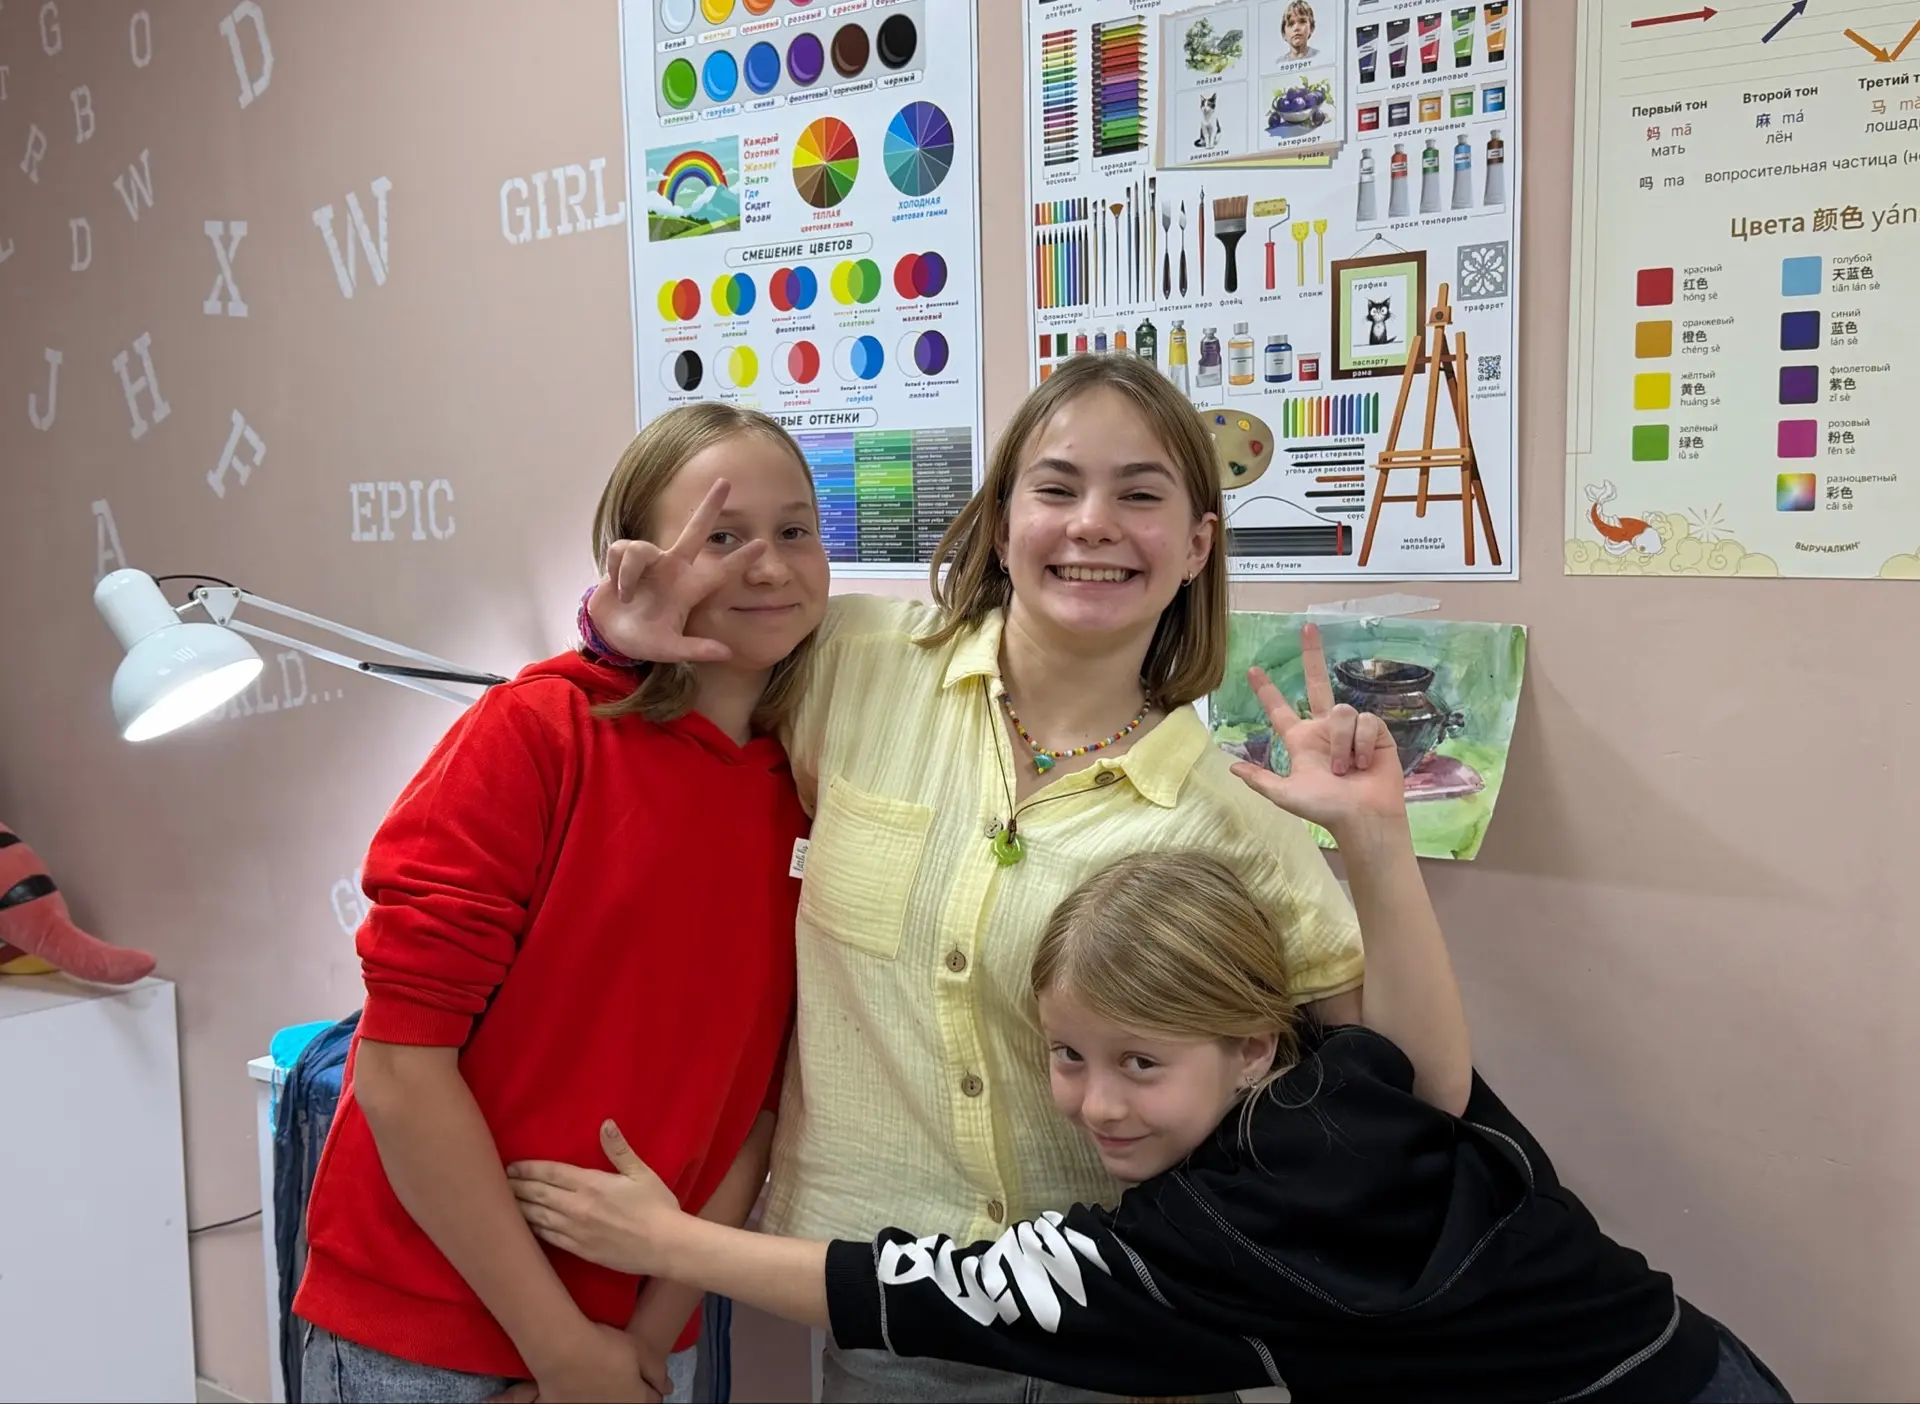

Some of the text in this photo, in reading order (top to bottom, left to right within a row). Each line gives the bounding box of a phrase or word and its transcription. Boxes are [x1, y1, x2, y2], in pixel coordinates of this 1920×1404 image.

[832, 0, 867, 16] красный
[1060, 7, 1082, 17] бумаги
[1394, 1, 1422, 11] краски
[787, 10, 822, 25] розовый
[40, 1, 62, 56] G
[742, 19, 779, 34] оранжевый
[129, 11, 151, 68] O
[664, 38, 687, 50] белый
[220, 0, 274, 109] D
[1280, 60, 1312, 71] портрет
[883, 73, 916, 87] черный
[1196, 76, 1223, 86] пейзаж
[1391, 72, 1469, 90] краски акриловые
[1858, 73, 1910, 91] Третий
[833, 81, 874, 95] коричневый
[1742, 85, 1819, 104] Второй тон
[789, 88, 829, 103] фиолетовый
[753, 99, 775, 110] синий
[1631, 99, 1708, 118] Первый тон
[1871, 99, 1887, 115] 马
[70, 85, 95, 143] B
[706, 105, 736, 119] голубой
[663, 113, 694, 126] зеленый
[1755, 109, 1805, 129] 麻 má
[1393, 122, 1466, 138] краски гуашевые
[1646, 123, 1692, 141] 妈 mā
[743, 133, 779, 148] Каждый
[1277, 135, 1321, 147] натюрморт
[1765, 131, 1793, 145] лён
[20, 124, 47, 184] R
[743, 147, 780, 161] Охотник
[1190, 150, 1230, 161] анимализм
[1297, 151, 1324, 160] бумага
[1650, 143, 1686, 158] мать
[743, 161, 777, 173] Желает
[1100, 160, 1137, 171] карандаши
[1639, 151, 1898, 191] 吗 ma вопросительная частица
[1104, 168, 1133, 177] цветные
[114, 148, 154, 222] W
[744, 174, 769, 186] Знать
[744, 188, 760, 201] Где
[744, 200, 771, 213] Сидит
[898, 196, 941, 210] ХОЛОДНАЯ
[745, 213, 772, 224] Фазан
[812, 209, 841, 220] ТЕПЛАЯ
[892, 208, 949, 224] цветовая гамма
[800, 220, 854, 234] цветовая гамма
[1390, 214, 1468, 231] краски темперные
[1730, 215, 1806, 242] Цвета
[1811, 204, 1865, 234] 颜色
[312, 176, 392, 299] W
[70, 218, 92, 272] D
[742, 239, 853, 262] СМЕШЕНИЕ ЦВЕТОВ
[1832, 253, 1873, 265] голубой
[204, 220, 248, 317] X
[1683, 264, 1723, 275] красный
[1832, 266, 1874, 282] 天蓝色
[1354, 281, 1388, 291] графика
[1683, 277, 1709, 291] 红色
[1832, 281, 1880, 293] tiān lán sè
[1259, 294, 1282, 302] валик
[1298, 291, 1323, 299] спонж
[1683, 291, 1718, 302] hóng sè
[1195, 302, 1213, 310] перо
[1464, 302, 1505, 313] трафарет
[902, 312, 943, 323] малиновый
[1831, 308, 1861, 318] синий
[839, 319, 875, 328] салатовый
[1682, 316, 1735, 328] оранжевый
[1830, 321, 1858, 335] 蓝色
[775, 324, 816, 335] фиолетовый
[1682, 330, 1708, 343] 橙色
[1830, 336, 1858, 346] lán sè
[1709, 343, 1721, 353] sè
[1352, 357, 1389, 367] паспарту
[1352, 369, 1372, 378] рама
[1680, 370, 1716, 380] жёлтый
[1829, 363, 1891, 375] фиолетовый
[28, 346, 63, 431] J
[112, 331, 171, 440] H
[1680, 382, 1707, 396] 黄色
[1829, 377, 1857, 391] 紫色
[1264, 387, 1286, 396] банка
[846, 394, 873, 405] голубой
[1680, 395, 1721, 408] huáng sè
[809, 413, 860, 426] ОТТЕНКИ
[1828, 418, 1871, 429] розовый
[1333, 436, 1365, 444] пастель
[1679, 436, 1705, 449] 绿色
[1827, 431, 1855, 445] 粉色
[1291, 451, 1319, 461] графит
[1845, 446, 1856, 456] sè
[1285, 465, 1365, 476] уголь для рисования
[1826, 473, 1897, 484] разноцветный
[1333, 481, 1365, 490] сангина
[1341, 496, 1365, 504] сепия
[1826, 486, 1854, 501] 彩色
[349, 478, 456, 542] EPIC
[1841, 501, 1853, 511] sè
[1347, 513, 1365, 521] соус
[92, 499, 127, 586] A
[1400, 542, 1446, 551] напольный
[1403, 536, 1443, 545] мольберт
[1239, 561, 1302, 570] тубус для бумаги
